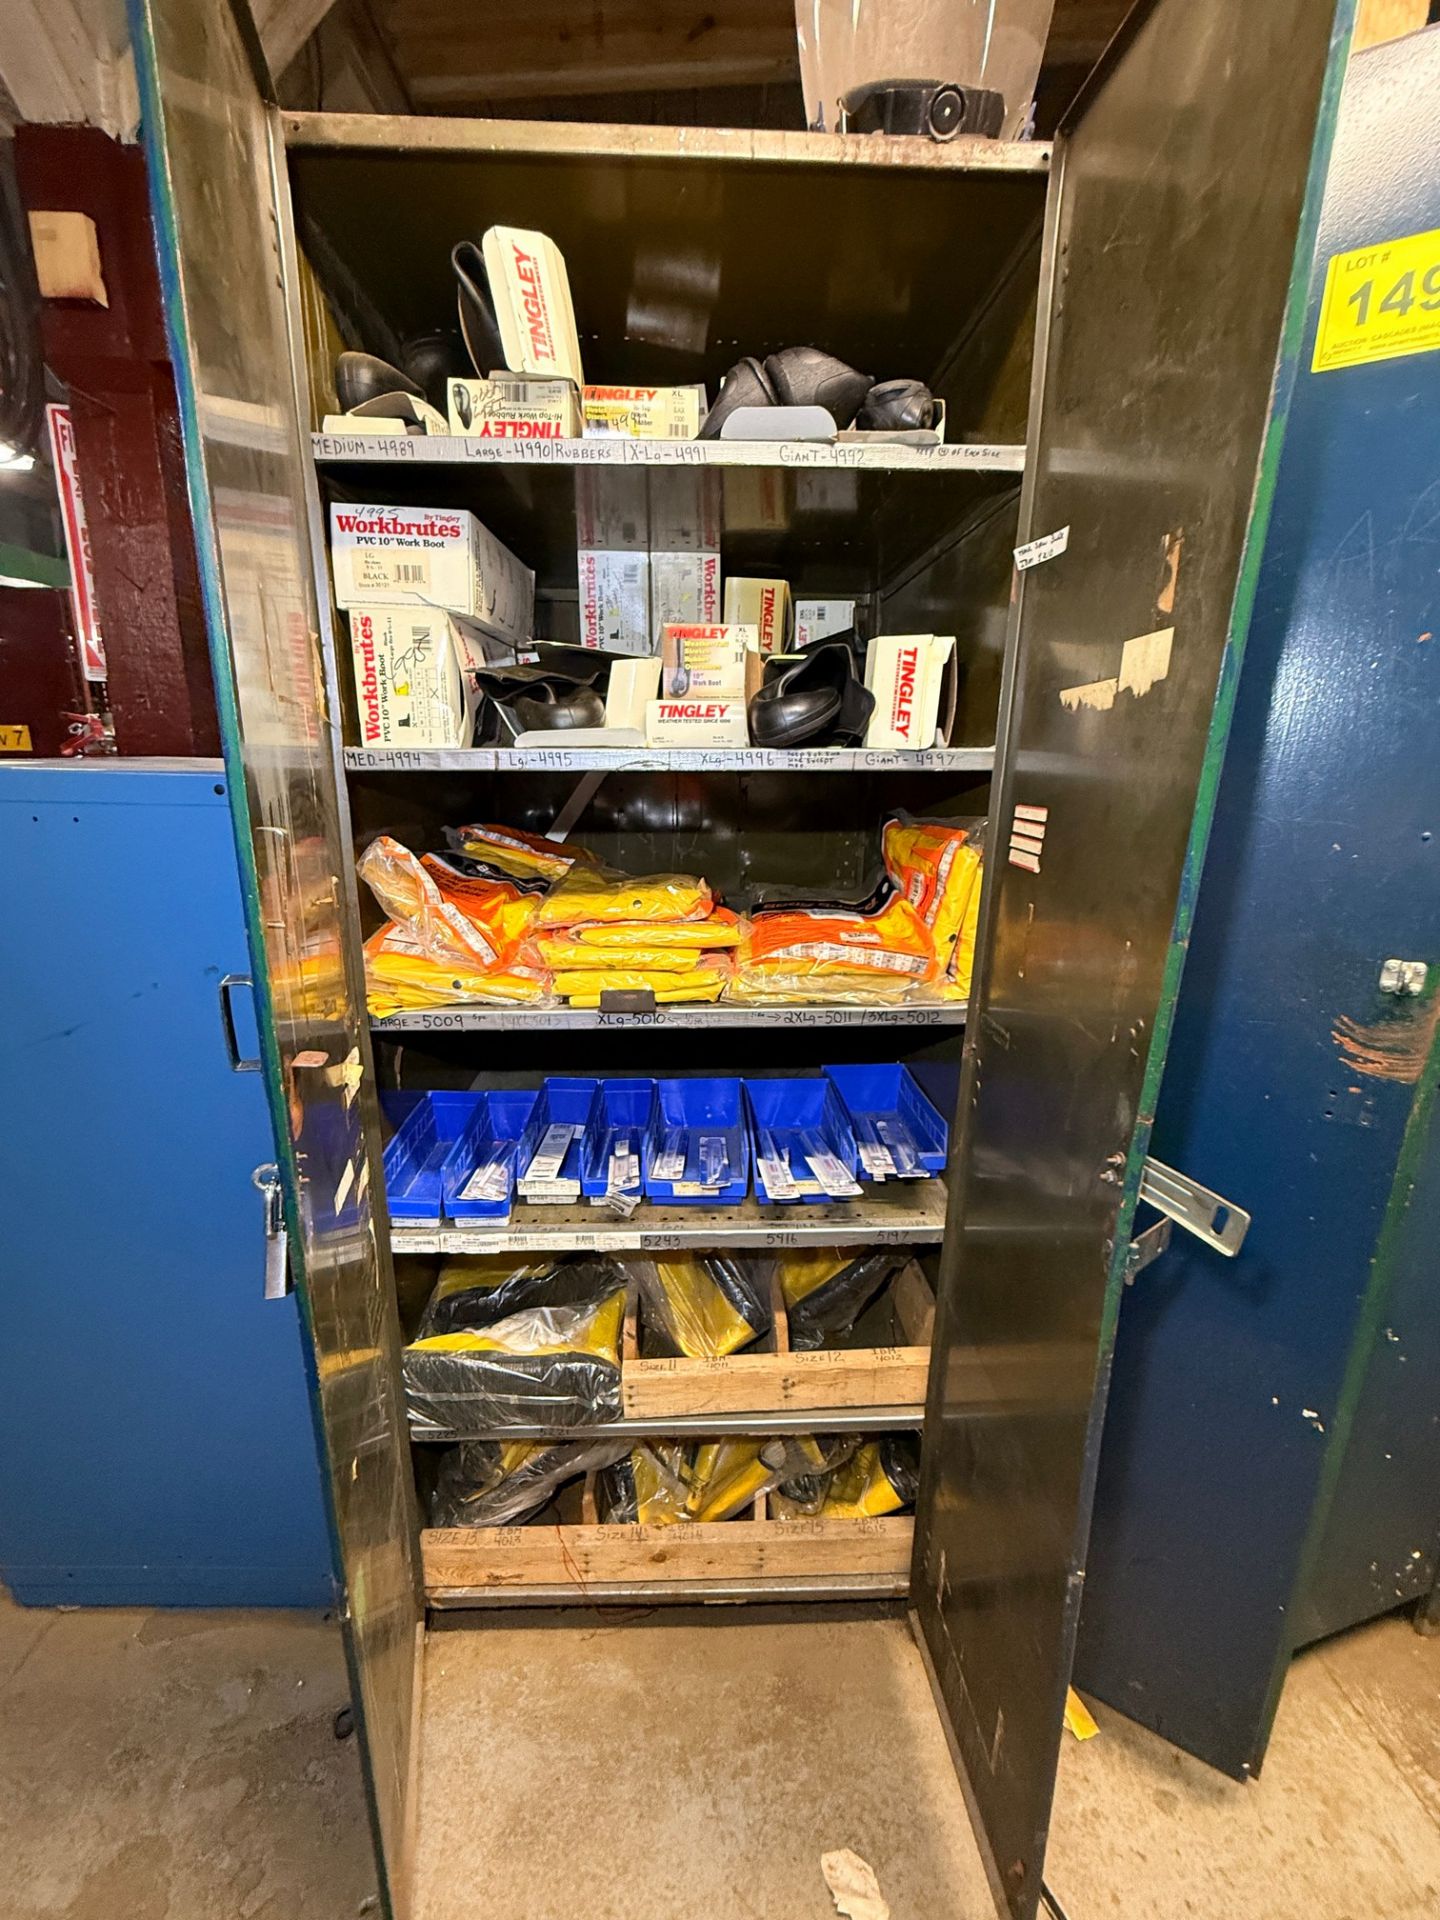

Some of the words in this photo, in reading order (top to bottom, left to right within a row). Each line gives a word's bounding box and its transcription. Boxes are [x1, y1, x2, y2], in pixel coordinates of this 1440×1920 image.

[1345, 254, 1378, 272] LOT
[512, 244, 549, 361] TINGLEY
[584, 386, 658, 401] TINGLEY
[480, 421, 564, 438] TINGLEY
[336, 514, 461, 538] Workbrutes
[356, 536, 377, 545] PVC
[396, 538, 420, 547] Work
[423, 539, 446, 548] Boot
[584, 556, 597, 649] Workbrutes
[762, 587, 775, 652] TINGLEY
[666, 627, 729, 639] TINGLEY
[378, 654, 386, 677] Boot
[360, 615, 381, 742] Workbrutes
[379, 679, 388, 703] Work
[896, 647, 918, 740] TINGLEY
[658, 704, 730, 718] TINGLEY
[12, 730, 23, 746] 7
[382, 722, 392, 742] PVC
[644, 1235, 681, 1247] 5243
[766, 1233, 798, 1245] 5916
